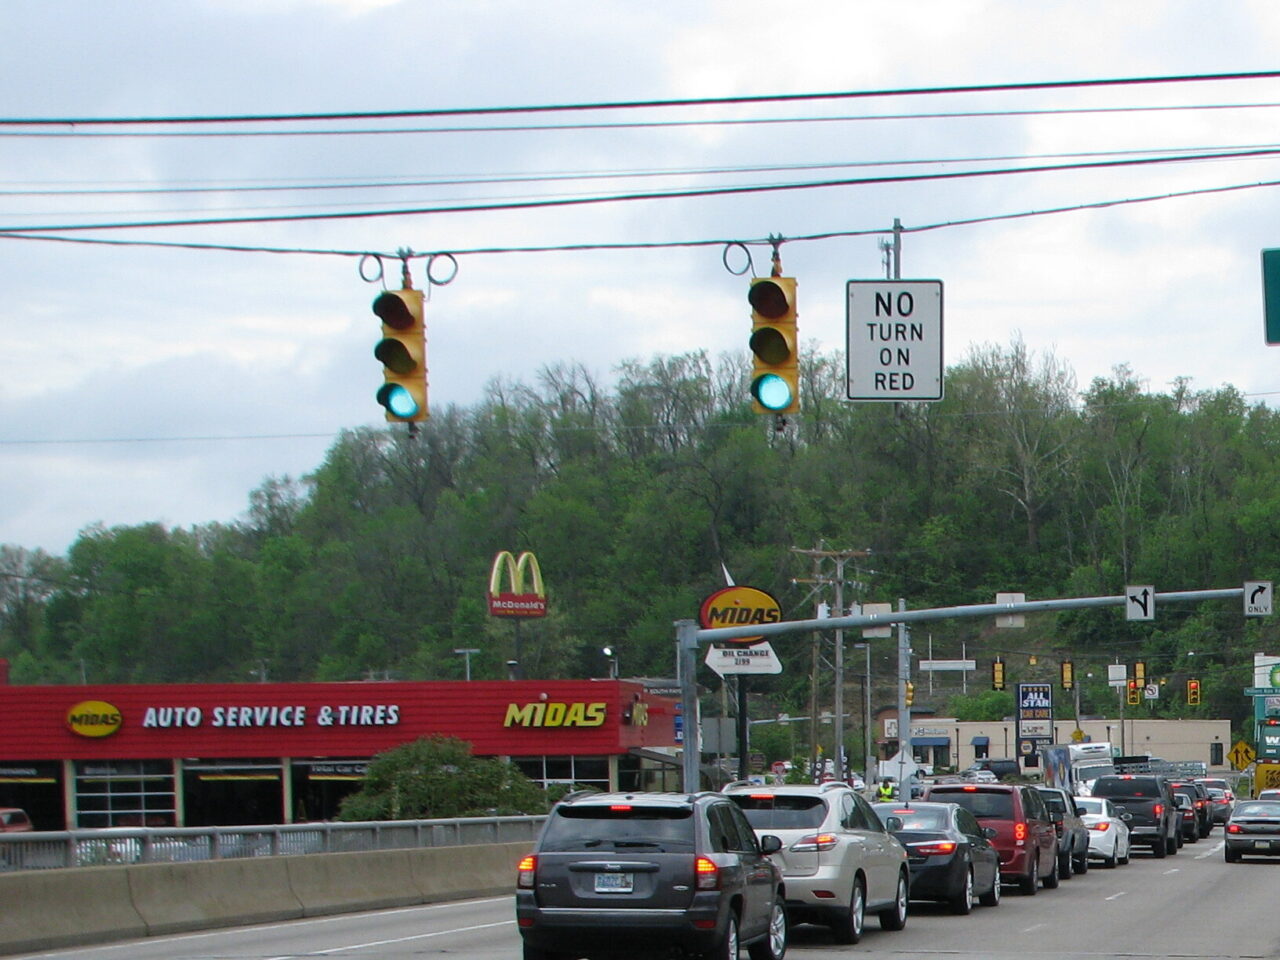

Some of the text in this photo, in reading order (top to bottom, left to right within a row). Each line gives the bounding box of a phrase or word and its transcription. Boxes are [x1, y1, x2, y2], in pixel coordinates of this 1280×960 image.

[875, 291, 914, 317] NO
[867, 323, 923, 341] TURN
[880, 347, 909, 366] ON
[875, 372, 914, 390] RED
[493, 600, 545, 609] McDonald's
[708, 606, 779, 624] MIDAS
[1023, 700, 1049, 708] STAR
[1027, 692, 1043, 700] ALL
[70, 712, 121, 727] MIDAS
[143, 707, 202, 728] AUTO
[212, 706, 306, 727] SERVICE
[503, 702, 608, 728] MIDAS
